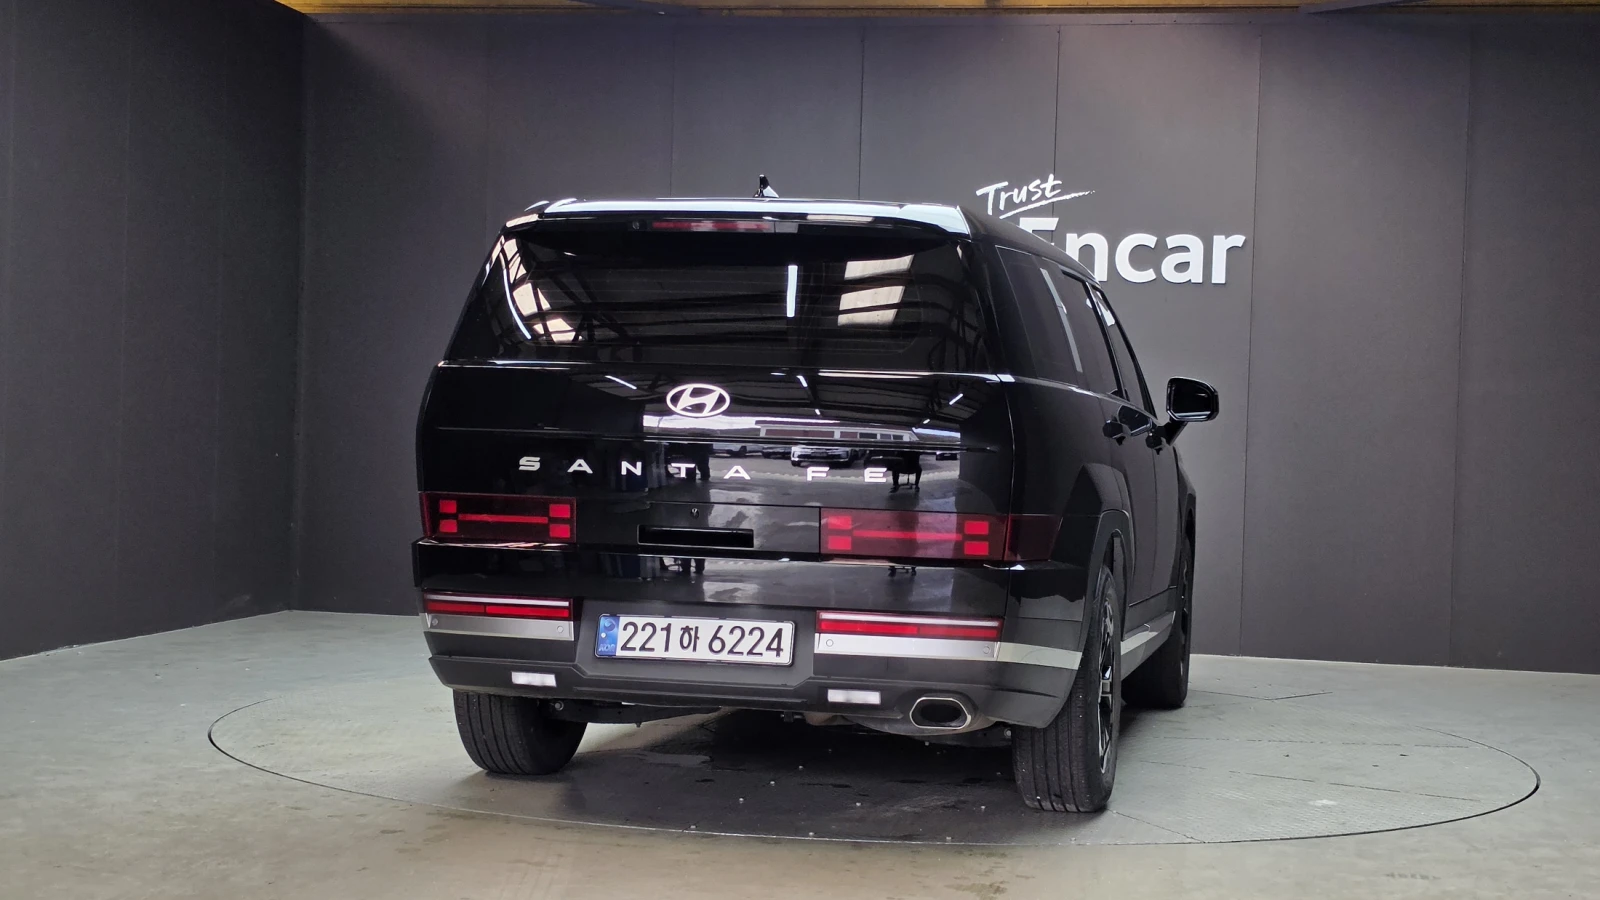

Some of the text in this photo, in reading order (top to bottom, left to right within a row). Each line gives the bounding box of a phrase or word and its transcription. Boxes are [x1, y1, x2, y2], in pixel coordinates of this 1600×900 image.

[976, 174, 1062, 216] Trust
[518, 456, 888, 483] SANTA FE
[620, 621, 784, 658] 221하 6224
